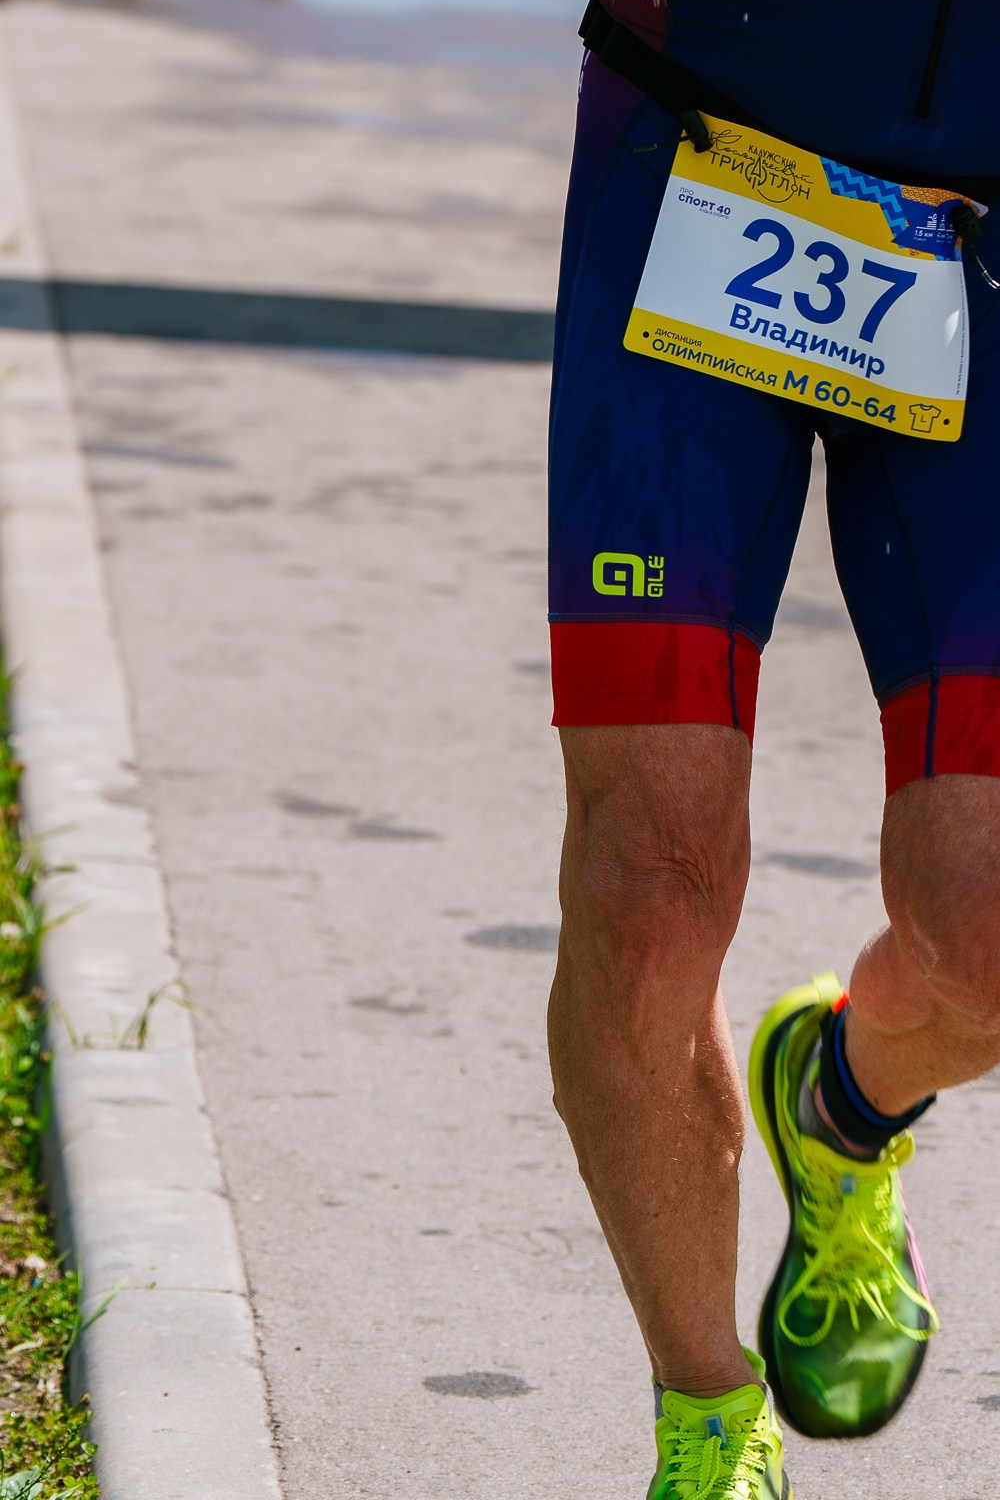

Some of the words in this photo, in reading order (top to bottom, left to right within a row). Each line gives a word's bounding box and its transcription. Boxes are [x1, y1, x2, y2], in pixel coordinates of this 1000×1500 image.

[678, 194, 715, 212] СПОРТ
[716, 205, 731, 216] 40
[679, 186, 694, 196] ПРО
[724, 219, 918, 343] 237
[654, 328, 703, 348] ДИСТАНЦИЯ
[729, 303, 886, 378] Владимир
[651, 338, 778, 387] ОЛИМПИЙСКАЯ
[814, 380, 897, 424] 60-64
